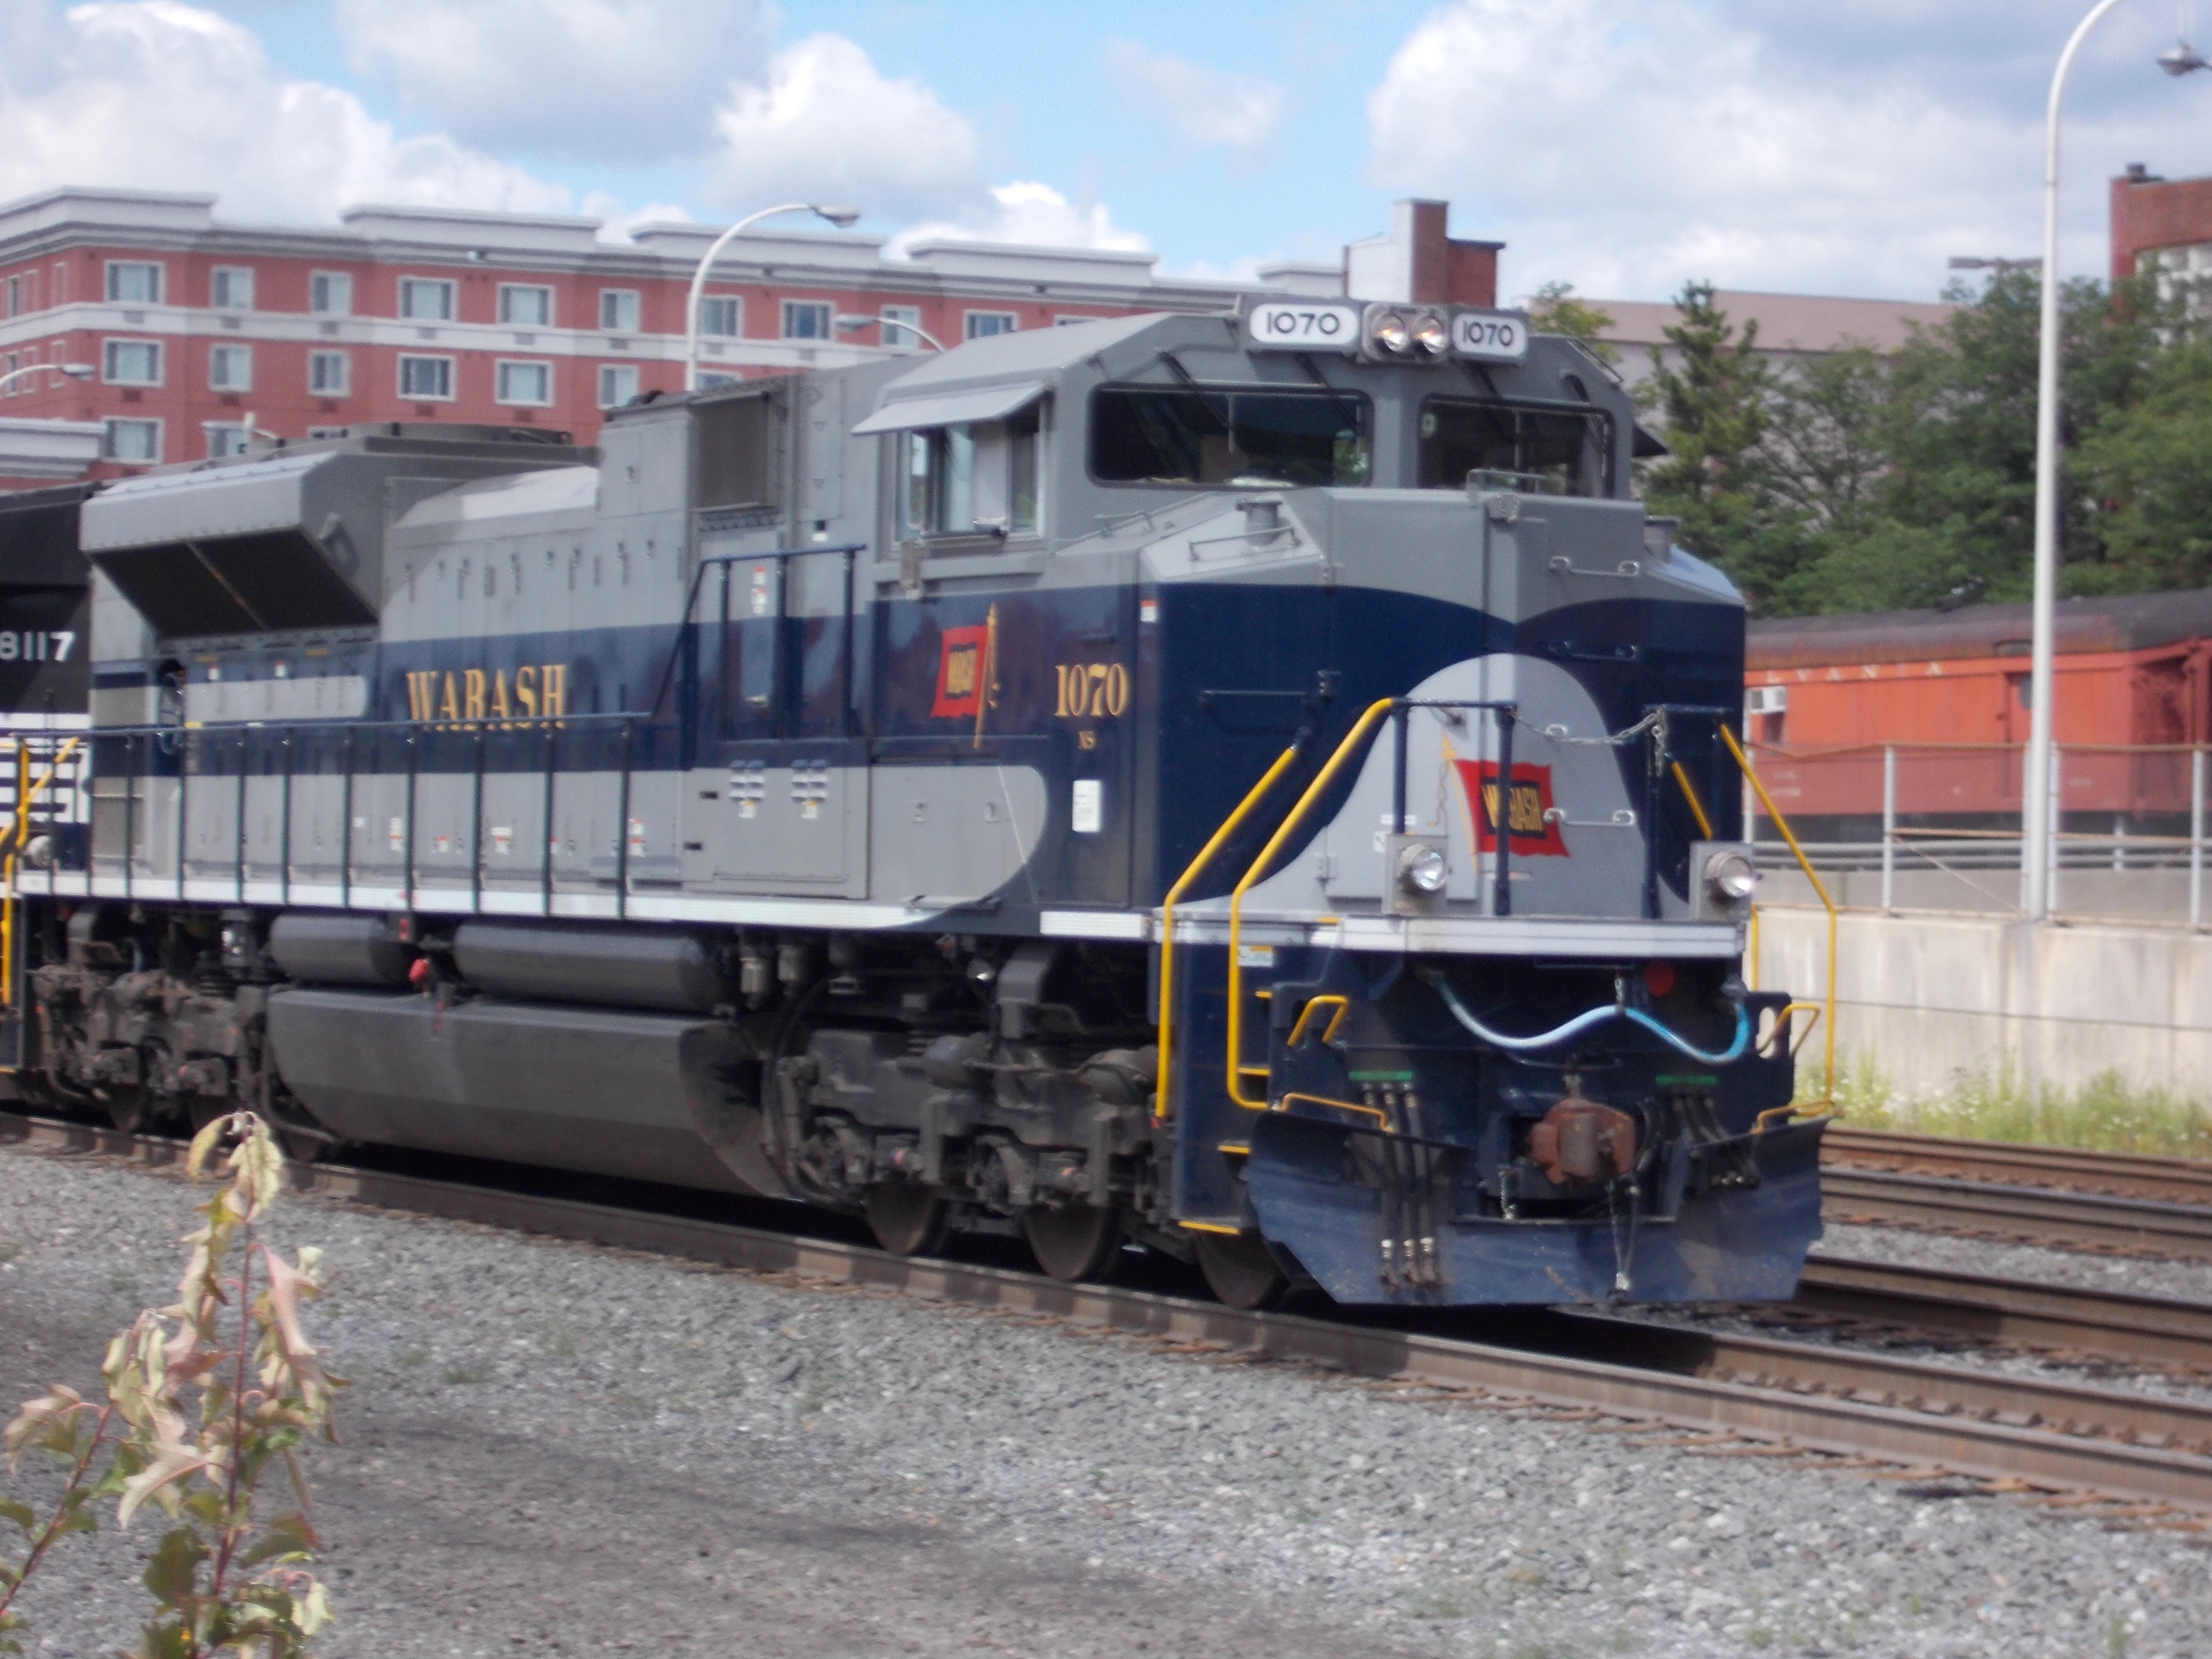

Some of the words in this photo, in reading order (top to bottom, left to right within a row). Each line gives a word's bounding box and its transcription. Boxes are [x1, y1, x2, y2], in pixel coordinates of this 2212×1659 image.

[1266, 311, 1340, 335] 1070
[1462, 321, 1513, 347] 1070
[0, 631, 76, 662] 8117
[406, 664, 567, 732] WABASH
[1055, 663, 1130, 717] 1070
